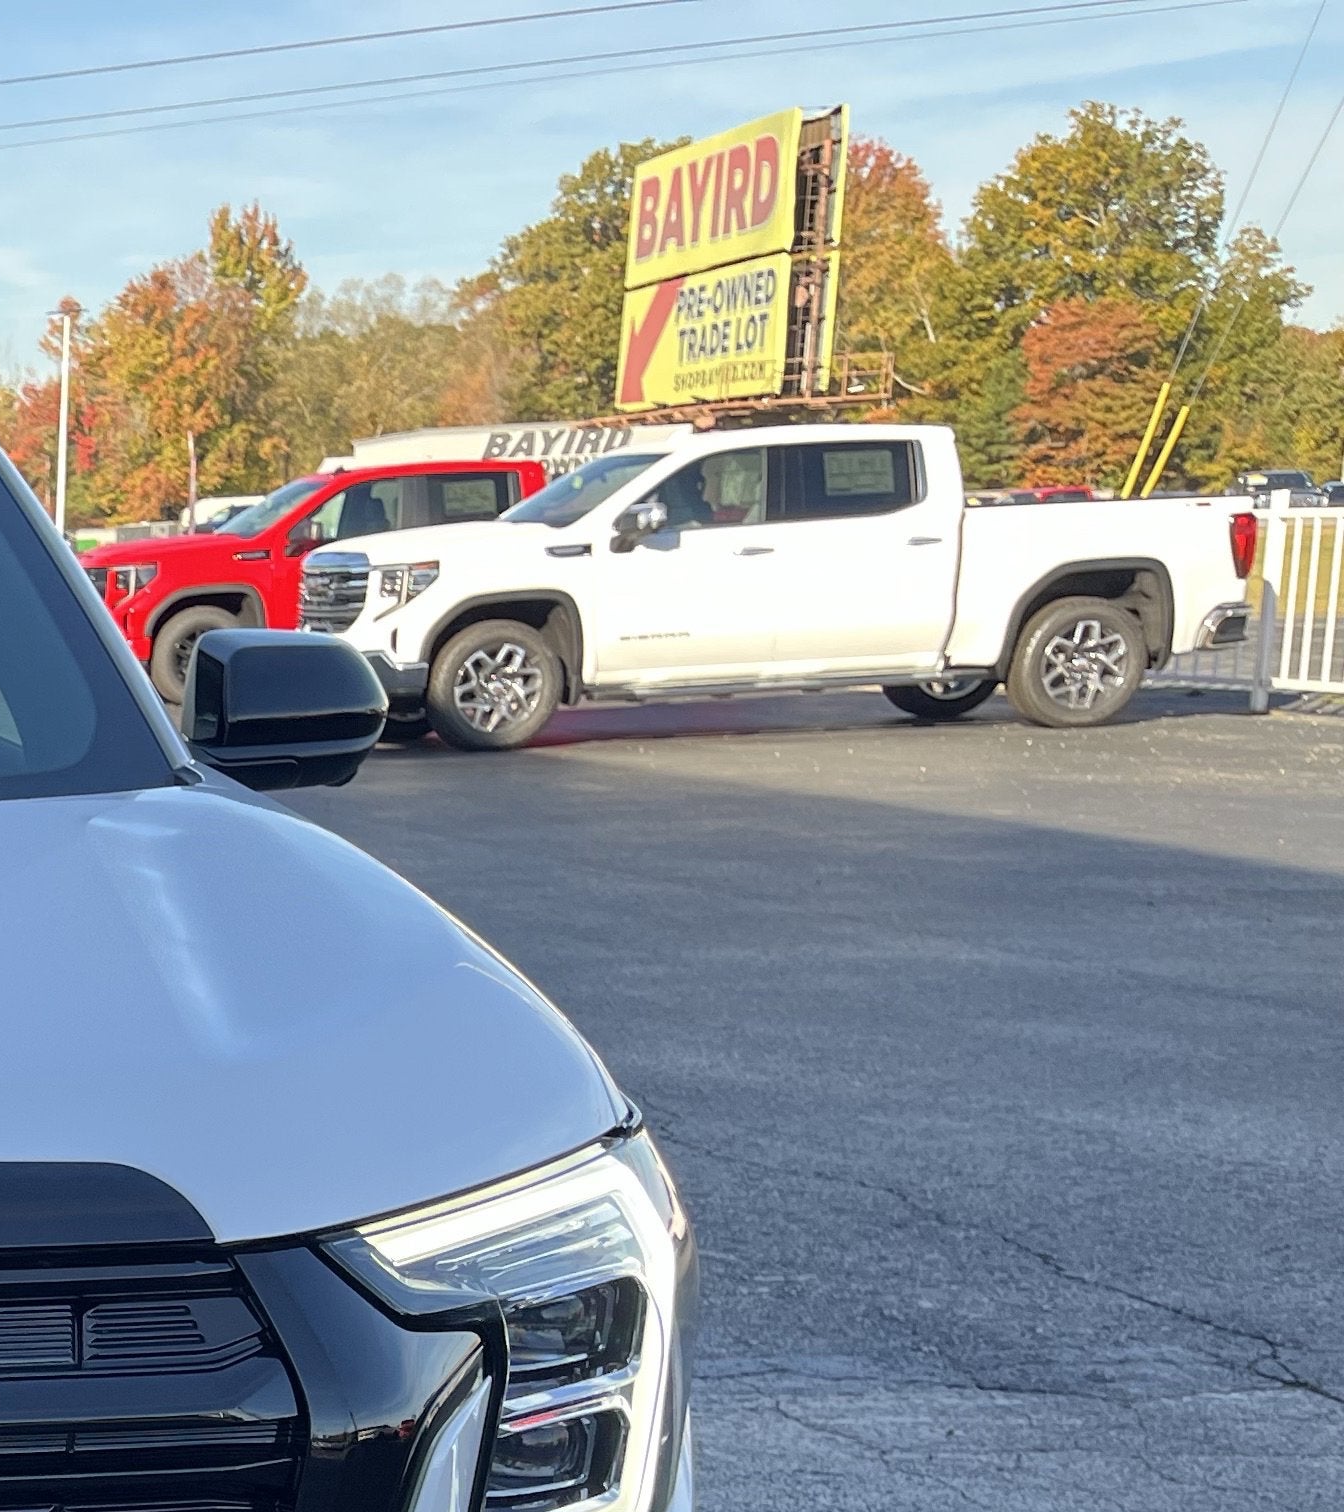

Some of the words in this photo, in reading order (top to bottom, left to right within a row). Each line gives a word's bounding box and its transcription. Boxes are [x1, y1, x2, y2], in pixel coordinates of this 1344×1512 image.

[636, 135, 778, 260] BAYIRD
[676, 269, 776, 321] PRE-OWNED
[678, 321, 731, 365] TRADE
[735, 313, 768, 353] LOT
[482, 427, 632, 460] BAYIRD
